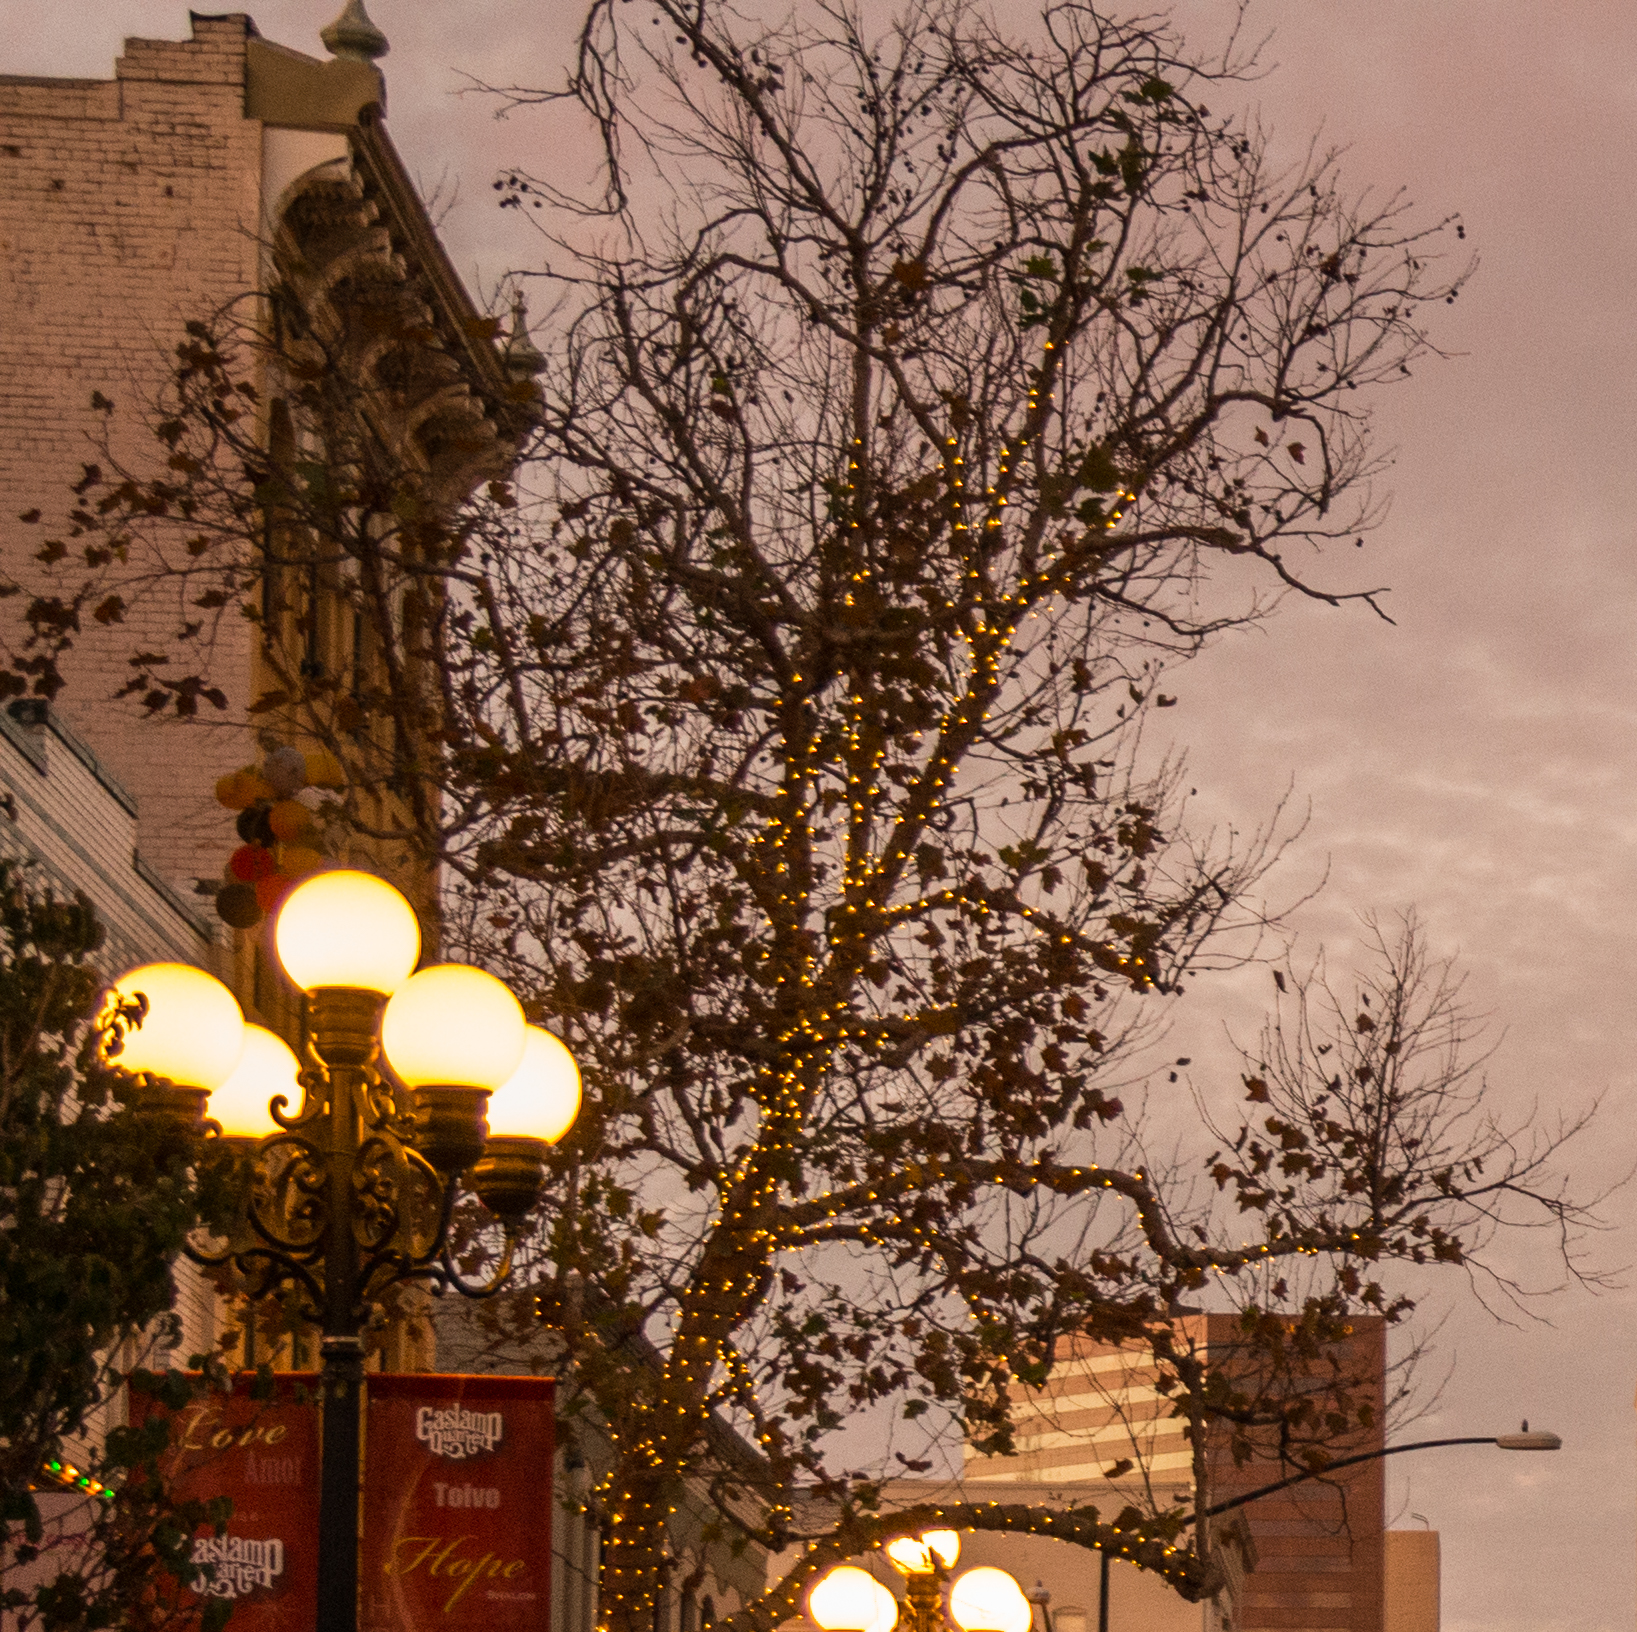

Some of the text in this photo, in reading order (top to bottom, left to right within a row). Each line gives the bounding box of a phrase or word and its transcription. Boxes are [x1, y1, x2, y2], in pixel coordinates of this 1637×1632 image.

[416, 1403, 502, 1441] Gaslamp
[188, 1533, 284, 1576] aslamp
[383, 1534, 526, 1612] Hope
